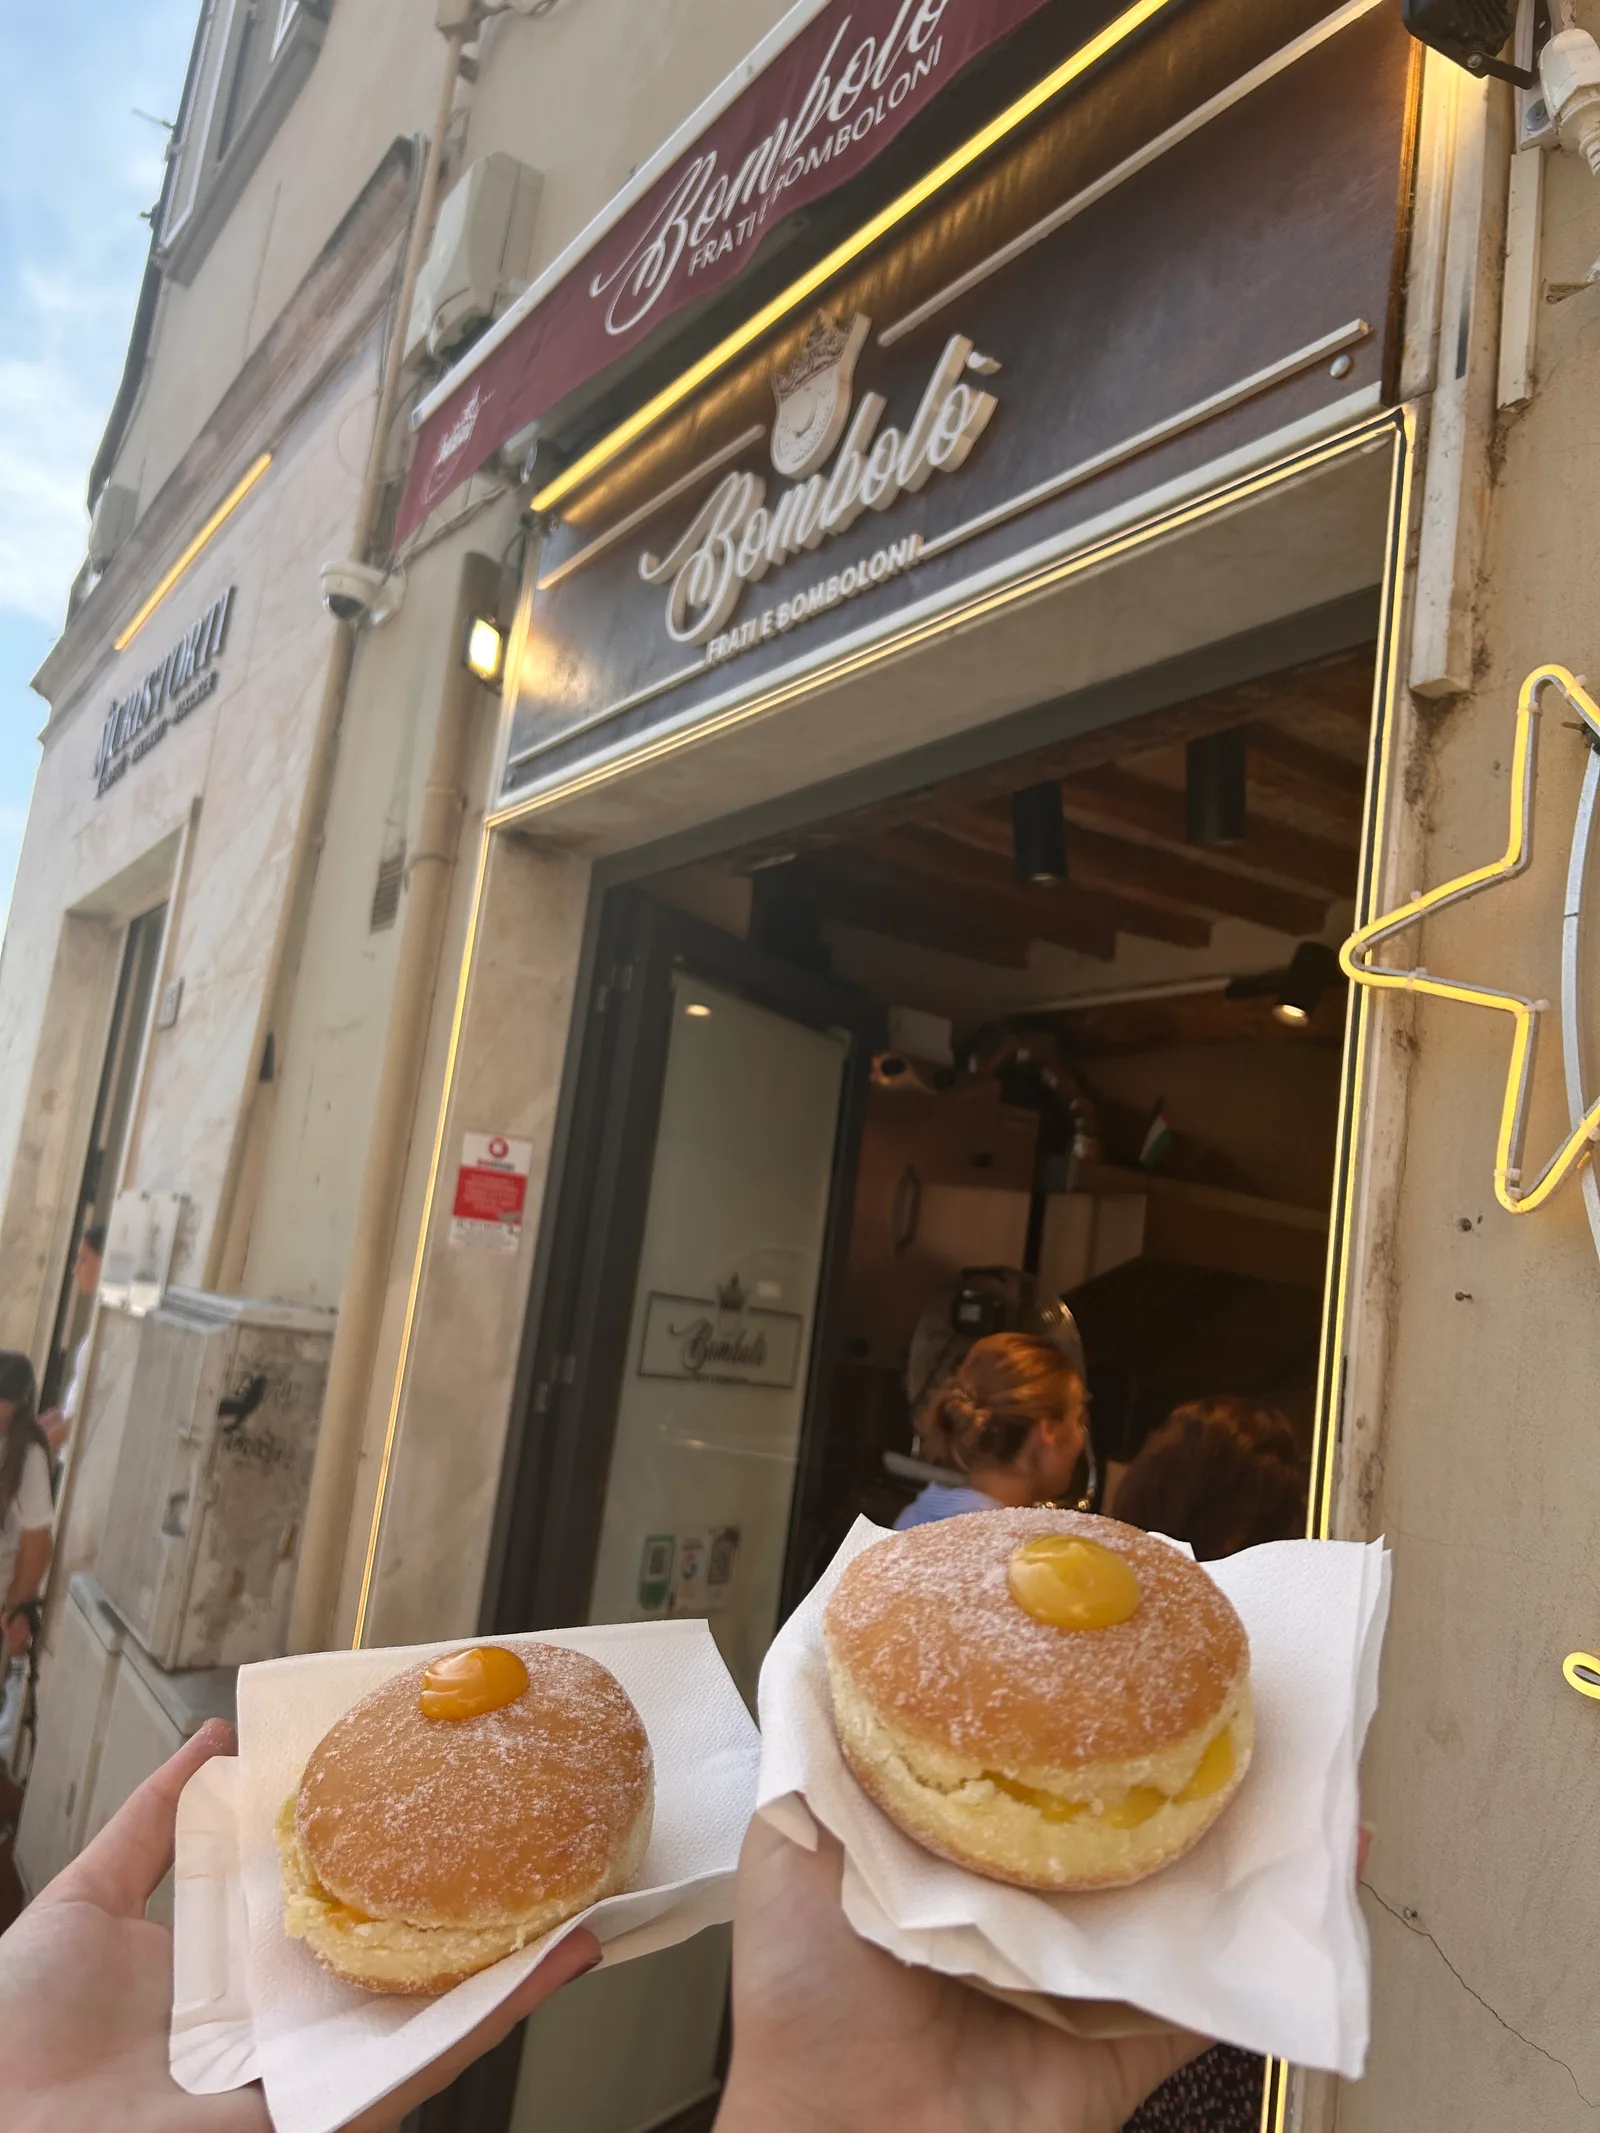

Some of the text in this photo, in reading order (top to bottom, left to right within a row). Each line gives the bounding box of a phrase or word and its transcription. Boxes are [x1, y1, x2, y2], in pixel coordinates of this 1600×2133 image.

[688, 209, 757, 276] FRATI
[703, 533, 924, 668] FRATI E BOMBOLONI
